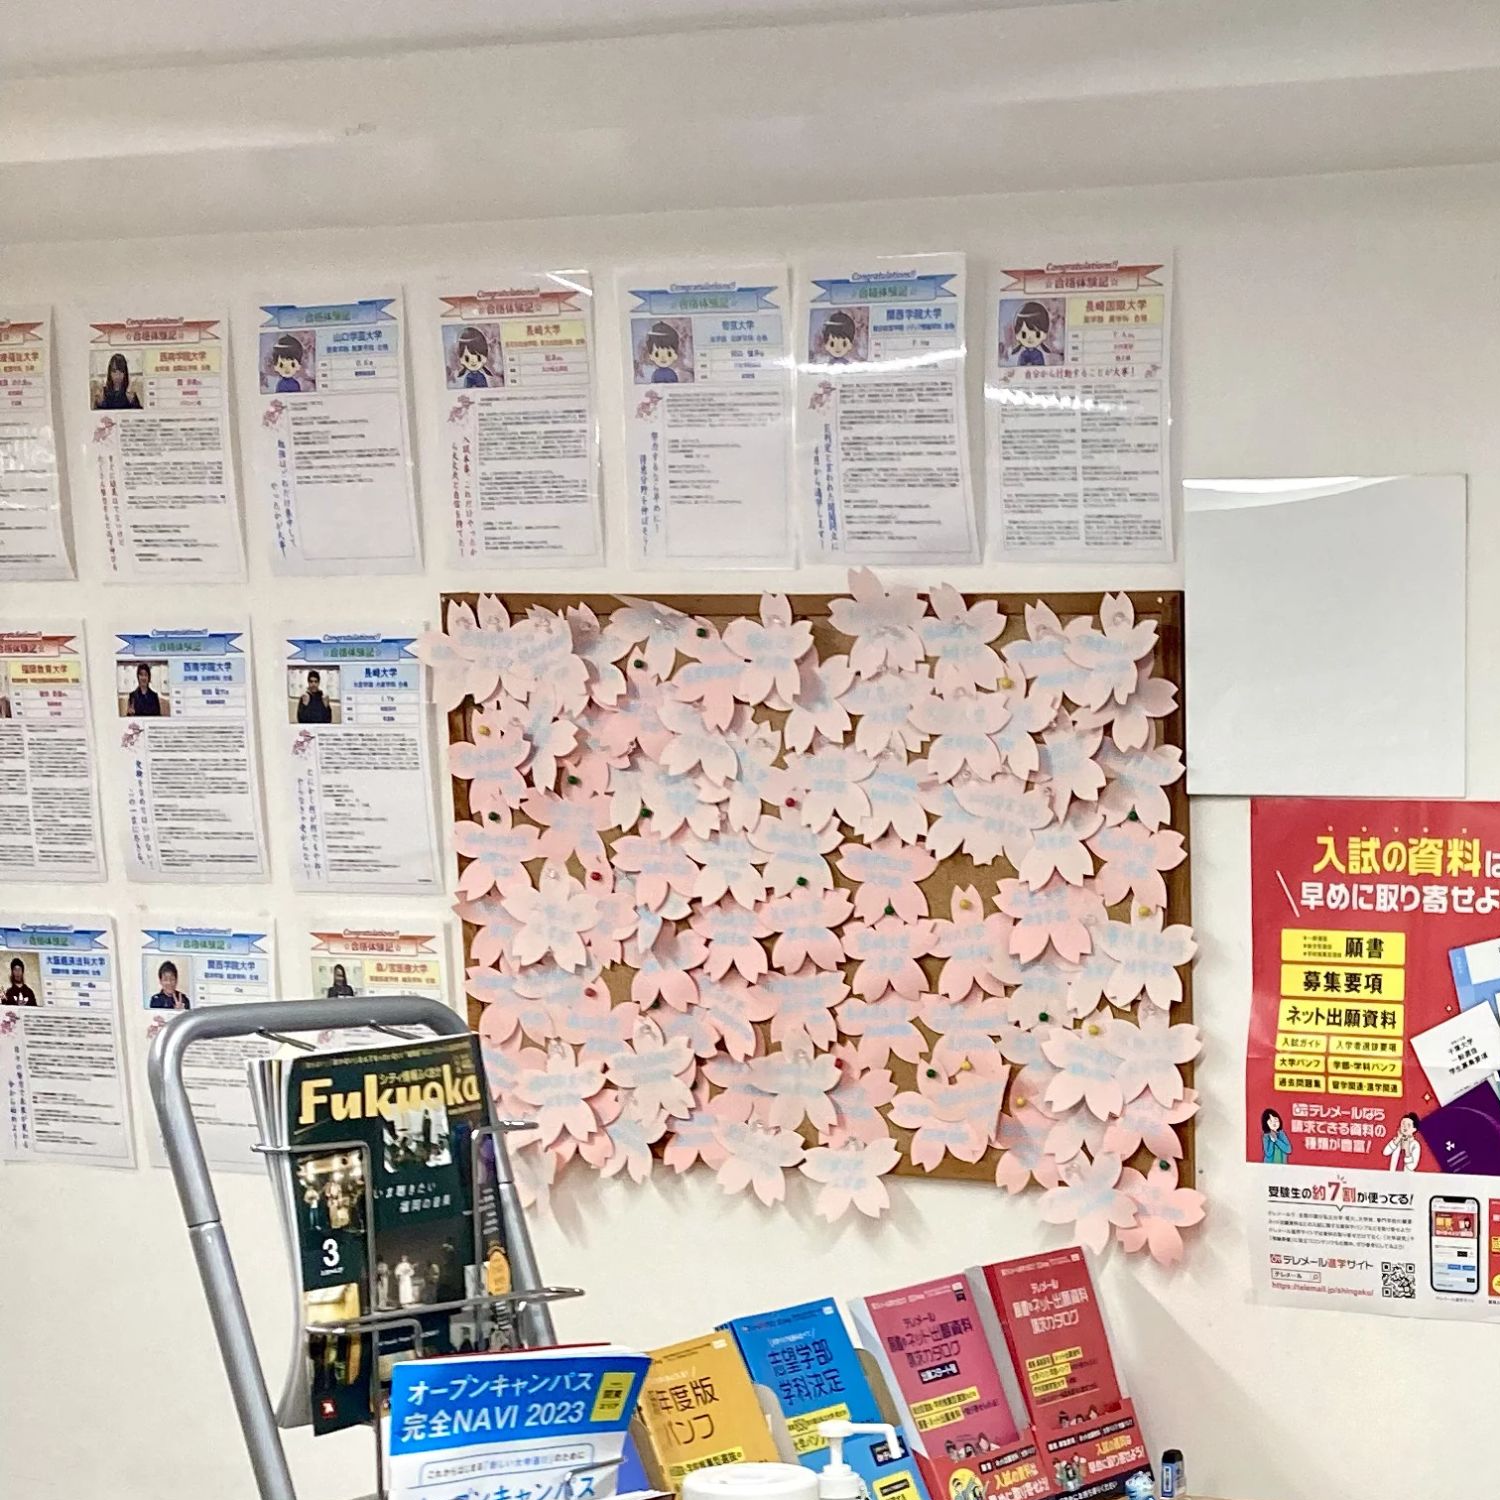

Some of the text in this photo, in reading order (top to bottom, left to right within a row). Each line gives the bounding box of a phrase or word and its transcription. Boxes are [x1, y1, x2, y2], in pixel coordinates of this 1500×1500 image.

[1345, 936, 1384, 959] 願書
[1303, 971, 1383, 995] 募集要項
[1286, 1006, 1397, 1029] ネット出願資料
[1282, 1037, 1321, 1048] 入試ガイド
[1336, 1040, 1397, 1053] 入学者選抜要項
[1280, 1058, 1320, 1067] 大学パンフ
[1333, 1061, 1396, 1072] 学部・学科パンフ
[298, 1064, 481, 1125] Fukuoka
[1279, 1078, 1322, 1088] 過去問題集
[322, 1238, 340, 1267] 3
[1283, 1255, 1374, 1271] テレメール進学サイト
[407, 1372, 594, 1406] オープンキャンパス
[779, 1368, 846, 1407] 学科決定
[401, 1400, 586, 1442] 完全NAVI 2023
